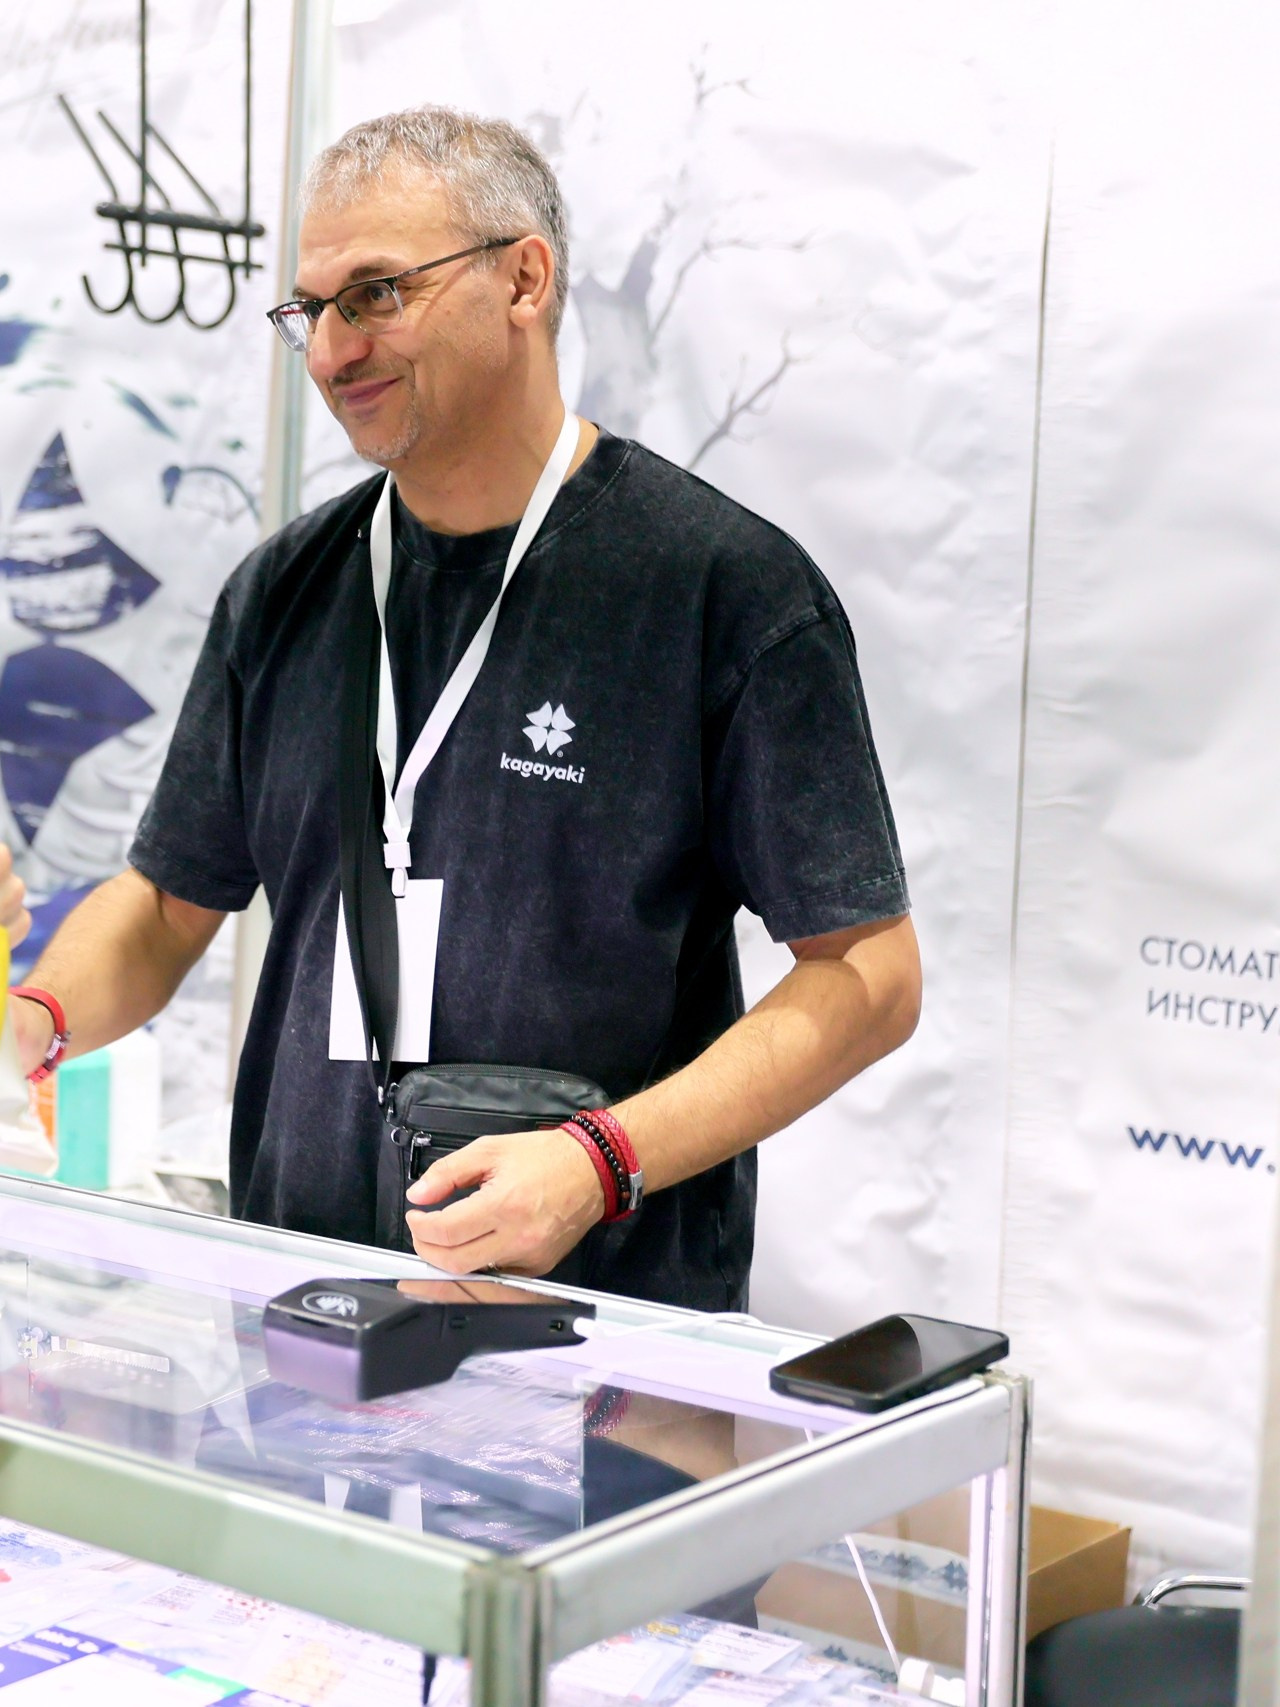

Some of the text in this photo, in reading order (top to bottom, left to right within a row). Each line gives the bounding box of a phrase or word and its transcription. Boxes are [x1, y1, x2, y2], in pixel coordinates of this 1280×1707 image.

[499, 751, 586, 784] kagayaki
[1139, 935, 1280, 981] СТОМАТ
[1147, 987, 1280, 1035] ИНСТРУ
[1126, 1126, 1277, 1174] www.
